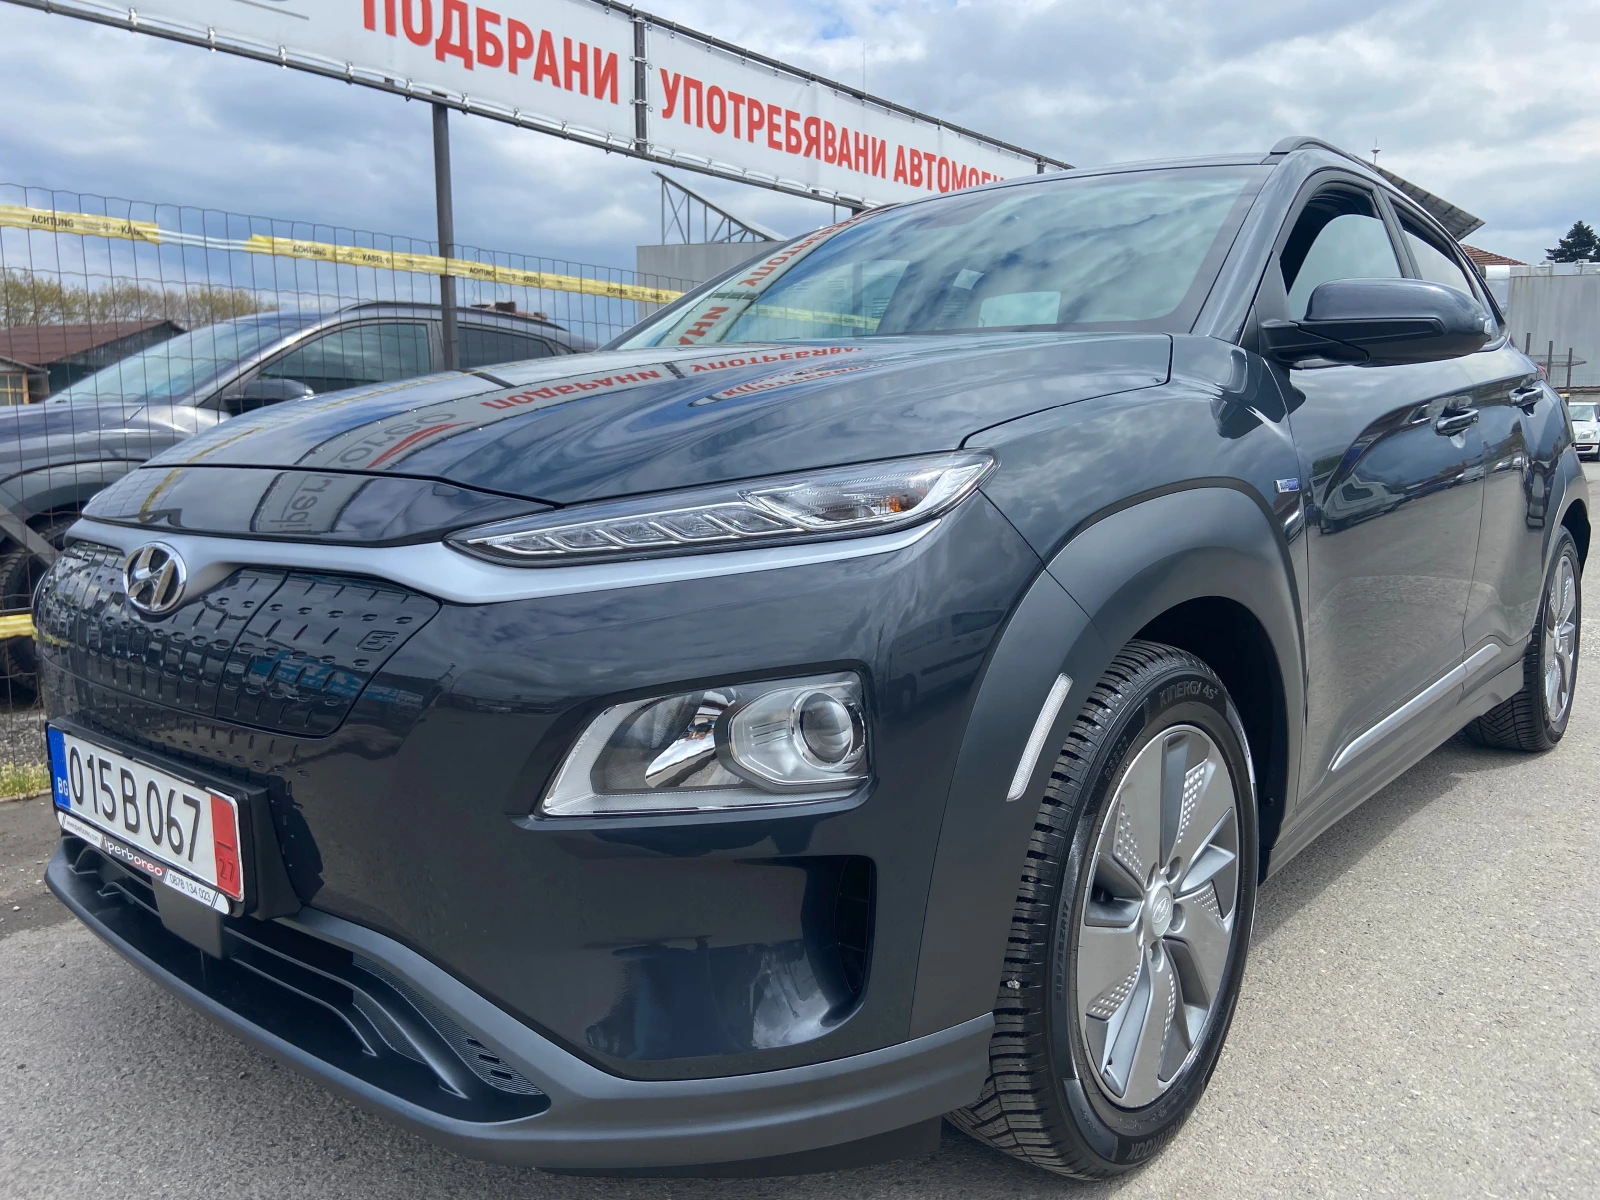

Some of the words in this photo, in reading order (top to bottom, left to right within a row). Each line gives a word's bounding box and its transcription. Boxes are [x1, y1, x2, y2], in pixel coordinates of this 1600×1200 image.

[659, 67, 887, 180] УПОТРЕБЯВАНИ
[893, 144, 1005, 194] АВТОМО
[31, 214, 74, 228] ACHTUNG
[292, 244, 327, 257] ACHTUNG
[362, 253, 383, 264] KABEL
[57, 776, 69, 796] BG
[69, 745, 202, 863] 015B067
[103, 836, 163, 877] iperboreo
[218, 857, 234, 883] 27
